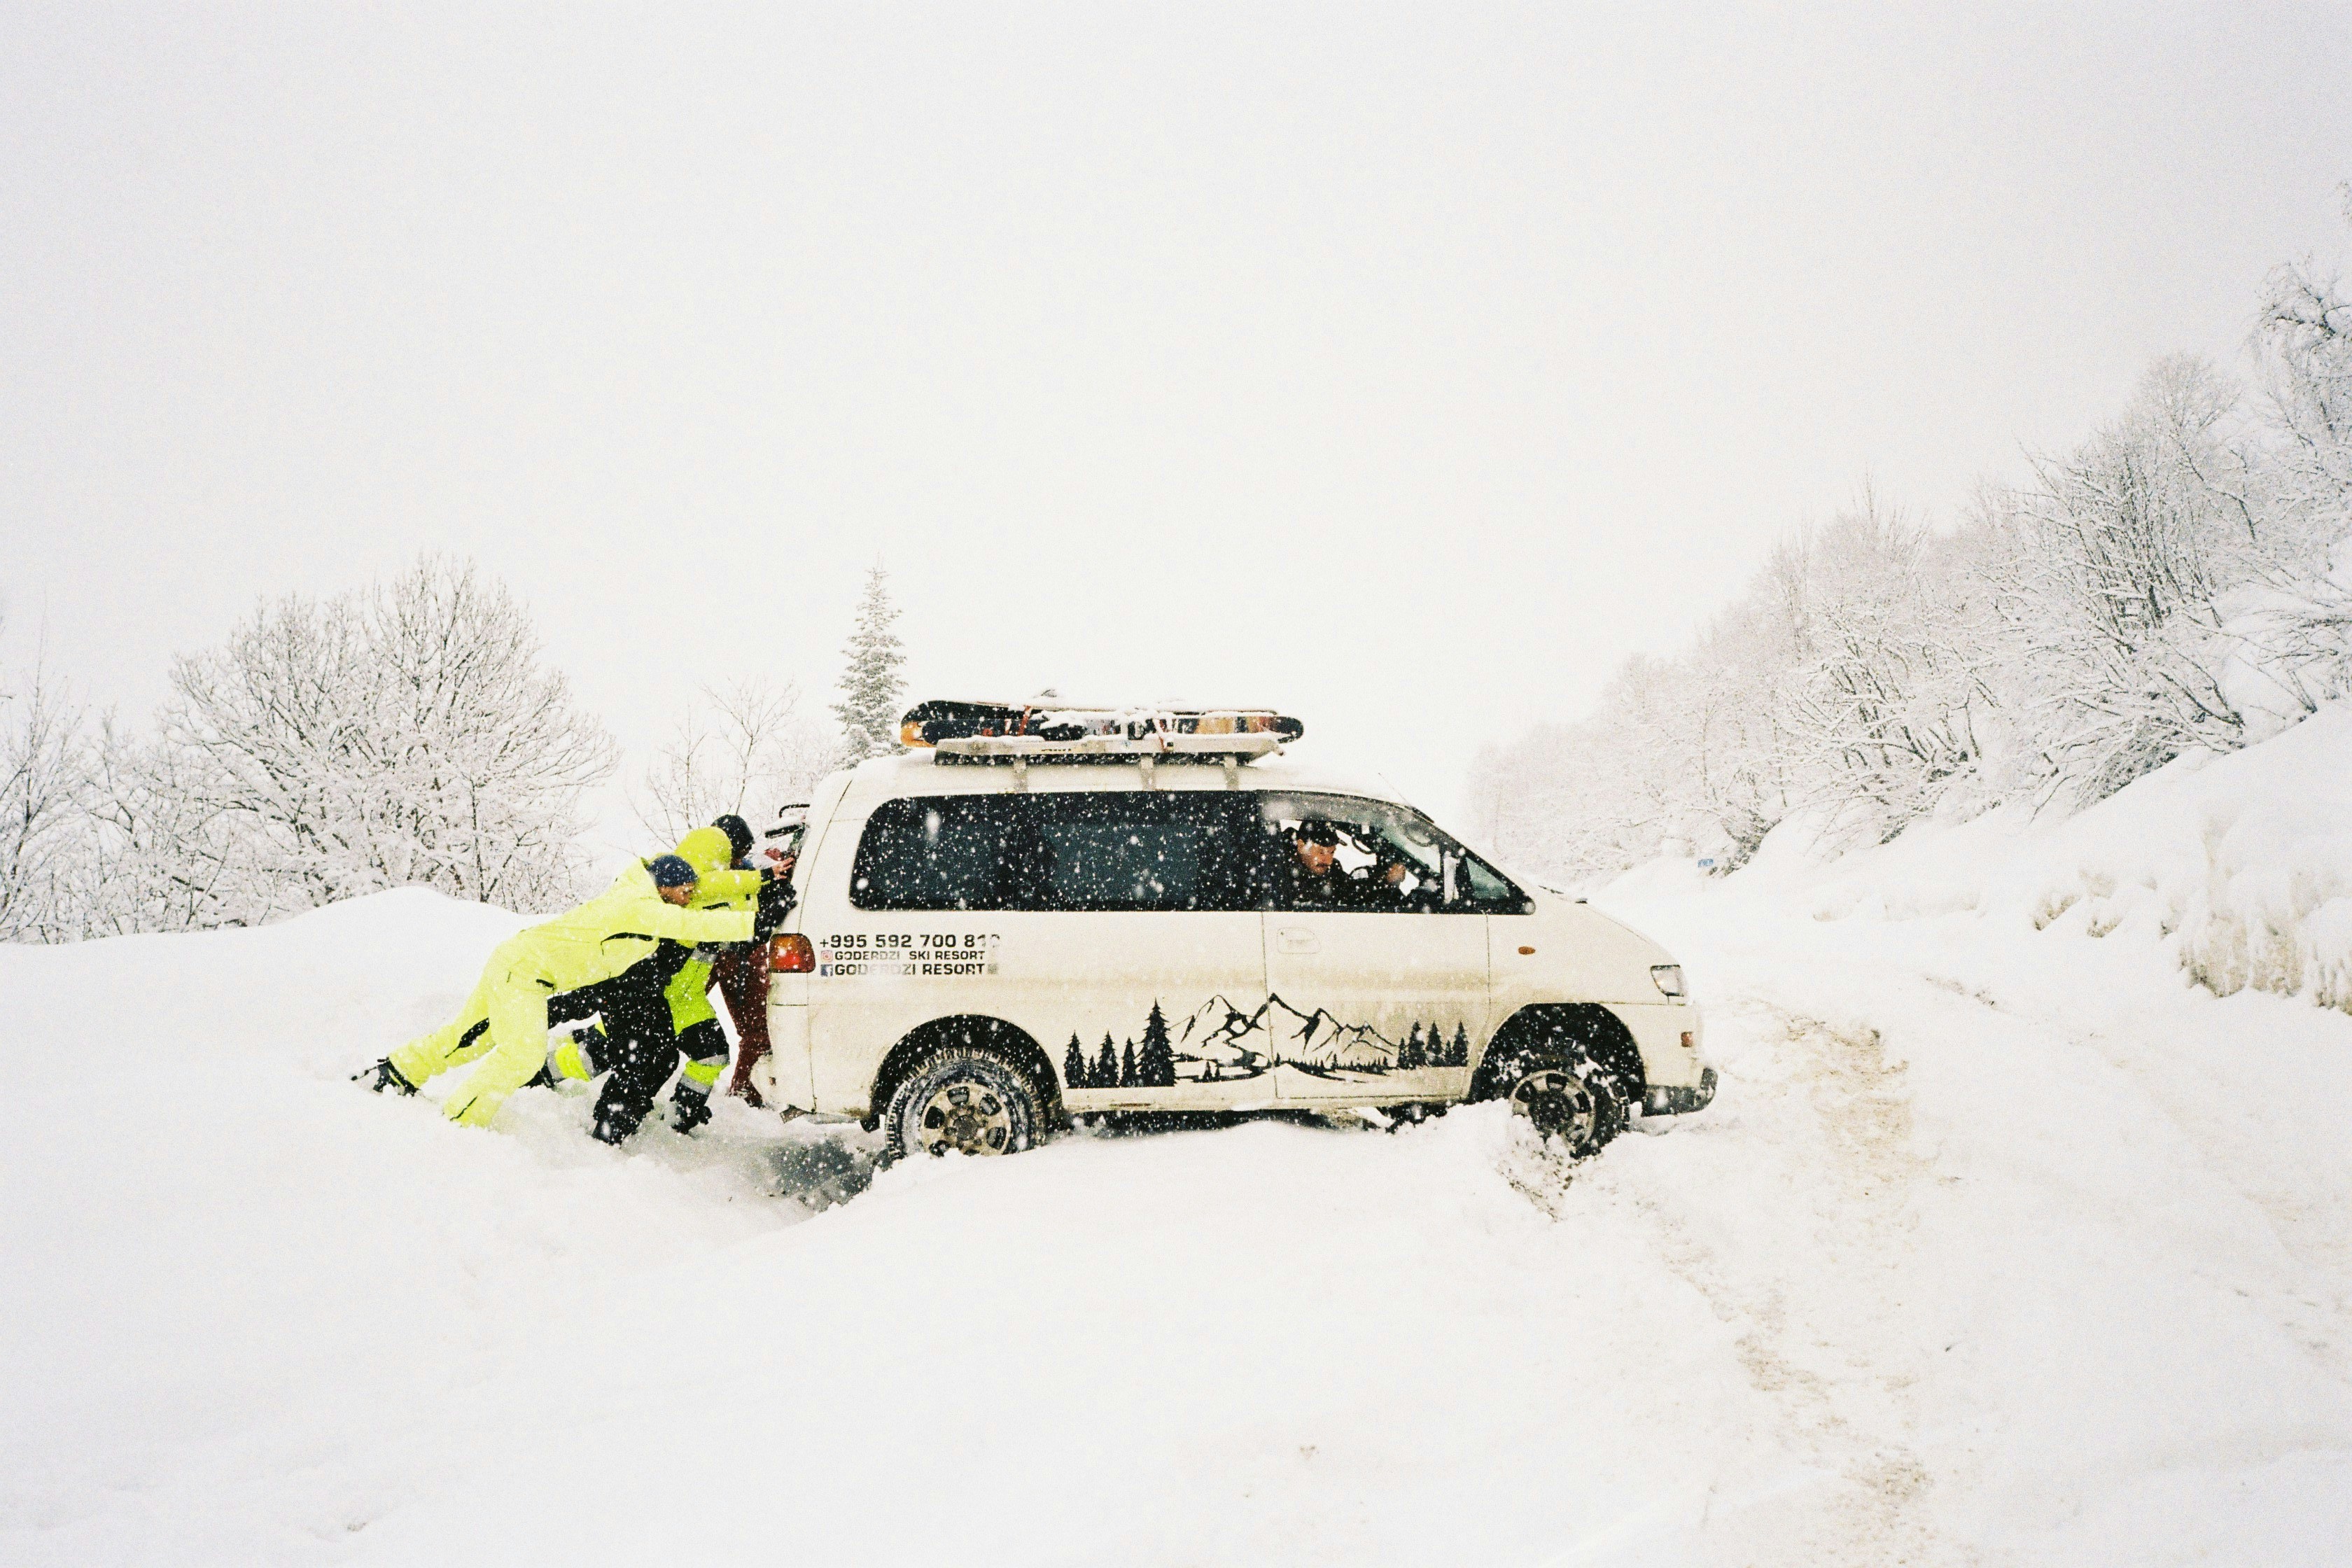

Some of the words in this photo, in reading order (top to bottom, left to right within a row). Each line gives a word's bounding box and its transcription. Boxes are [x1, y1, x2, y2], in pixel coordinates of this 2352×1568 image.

[820, 934, 867, 948] +995
[875, 934, 911, 948] 592
[920, 934, 956, 948] 700
[835, 951, 899, 960] GODERDZI
[909, 951, 930, 960] SKI
[935, 951, 985, 960] RESORT
[923, 963, 985, 975] RESORT
